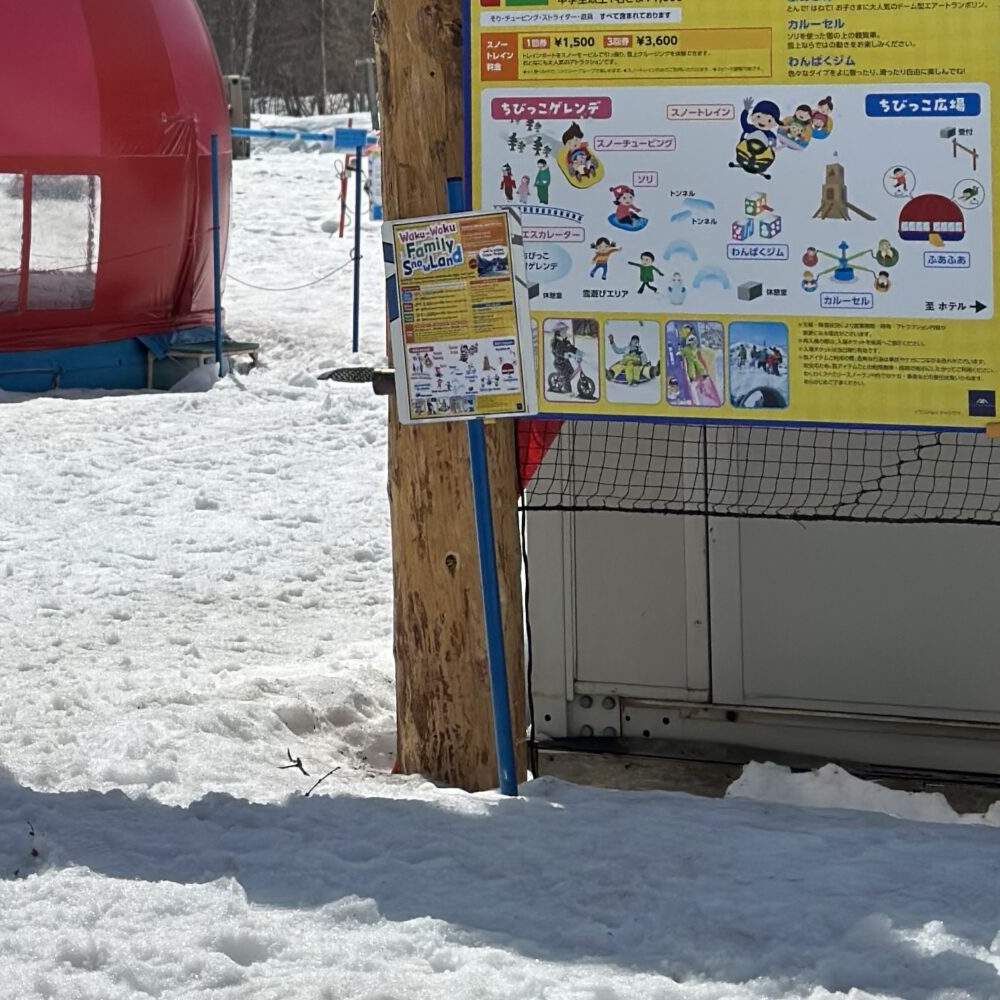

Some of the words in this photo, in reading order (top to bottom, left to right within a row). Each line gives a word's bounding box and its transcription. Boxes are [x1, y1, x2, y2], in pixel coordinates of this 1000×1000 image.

[788, 18, 845, 30] カルーセル
[486, 40, 509, 49] スノー
[554, 36, 595, 48] ¥1,500
[636, 35, 678, 46] ¥3,600
[486, 51, 514, 60] トレイン
[500, 101, 602, 116] ちびっこゲレンデ
[879, 97, 966, 113] ちびっこ広場
[671, 107, 731, 118] スノートレイン
[597, 137, 674, 149] スノーチュービング
[637, 174, 654, 185] ソリ
[669, 189, 696, 198] トンネル
[691, 217, 718, 226] トンネル
[406, 236, 454, 259] Family
[927, 254, 967, 265] ふあふあ
[582, 288, 629, 299] 雪遊びエリア
[822, 295, 871, 307] カルーセル
